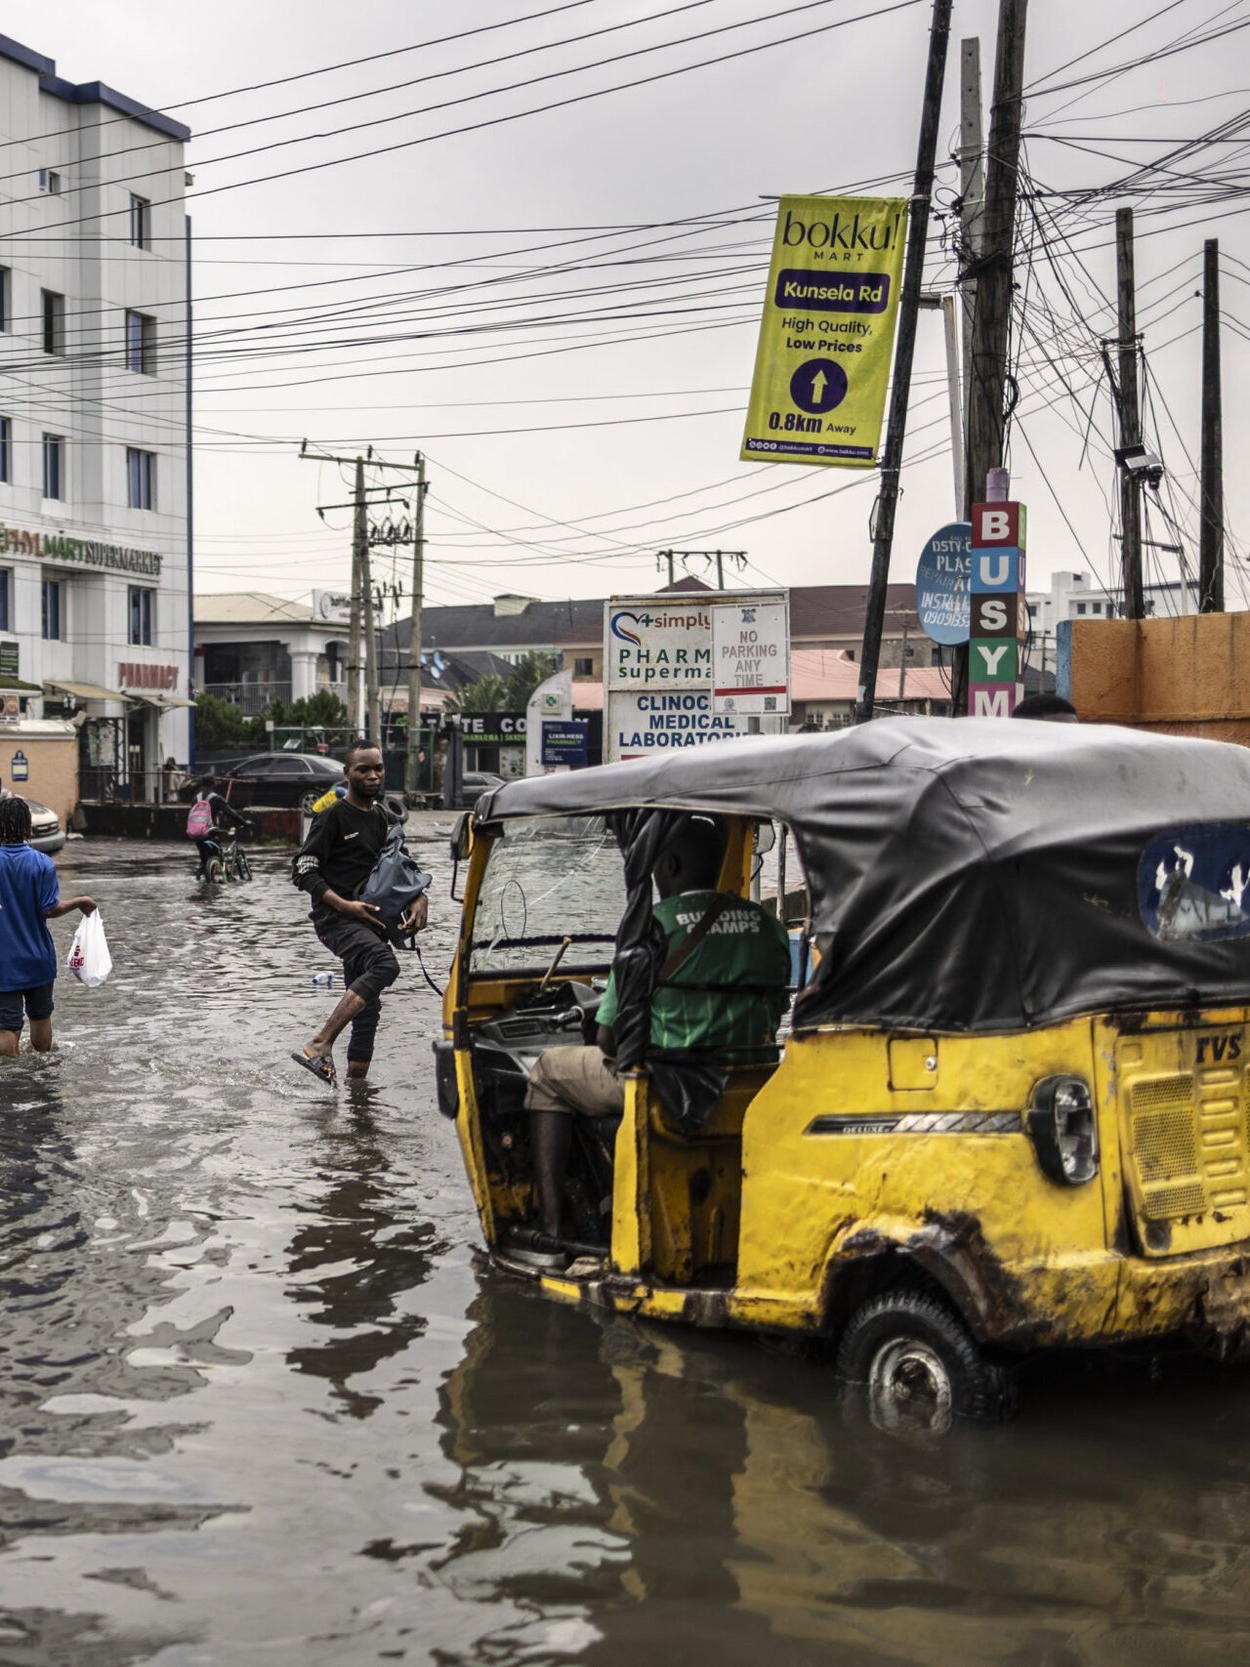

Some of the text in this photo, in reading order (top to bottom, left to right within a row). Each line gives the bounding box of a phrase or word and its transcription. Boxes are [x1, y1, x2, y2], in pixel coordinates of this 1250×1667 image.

[782, 210, 900, 251] bokku!
[813, 251, 864, 262] MART
[783, 281, 883, 302] Kunsela Rd
[782, 317, 873, 338] High Quality,
[786, 337, 862, 353] Low Prices
[769, 411, 857, 436] 0.8km Away
[85, 540, 164, 576] SUPERMARKET
[739, 631, 758, 643] NO
[722, 644, 777, 658] PARKING
[735, 659, 761, 672] ANY
[118, 662, 180, 690] PHARMACY
[734, 674, 764, 687] TIME
[650, 714, 735, 729] MEDICAL
[676, 910, 762, 926] BUDING
[842, 1126, 885, 1134] DELUXE
